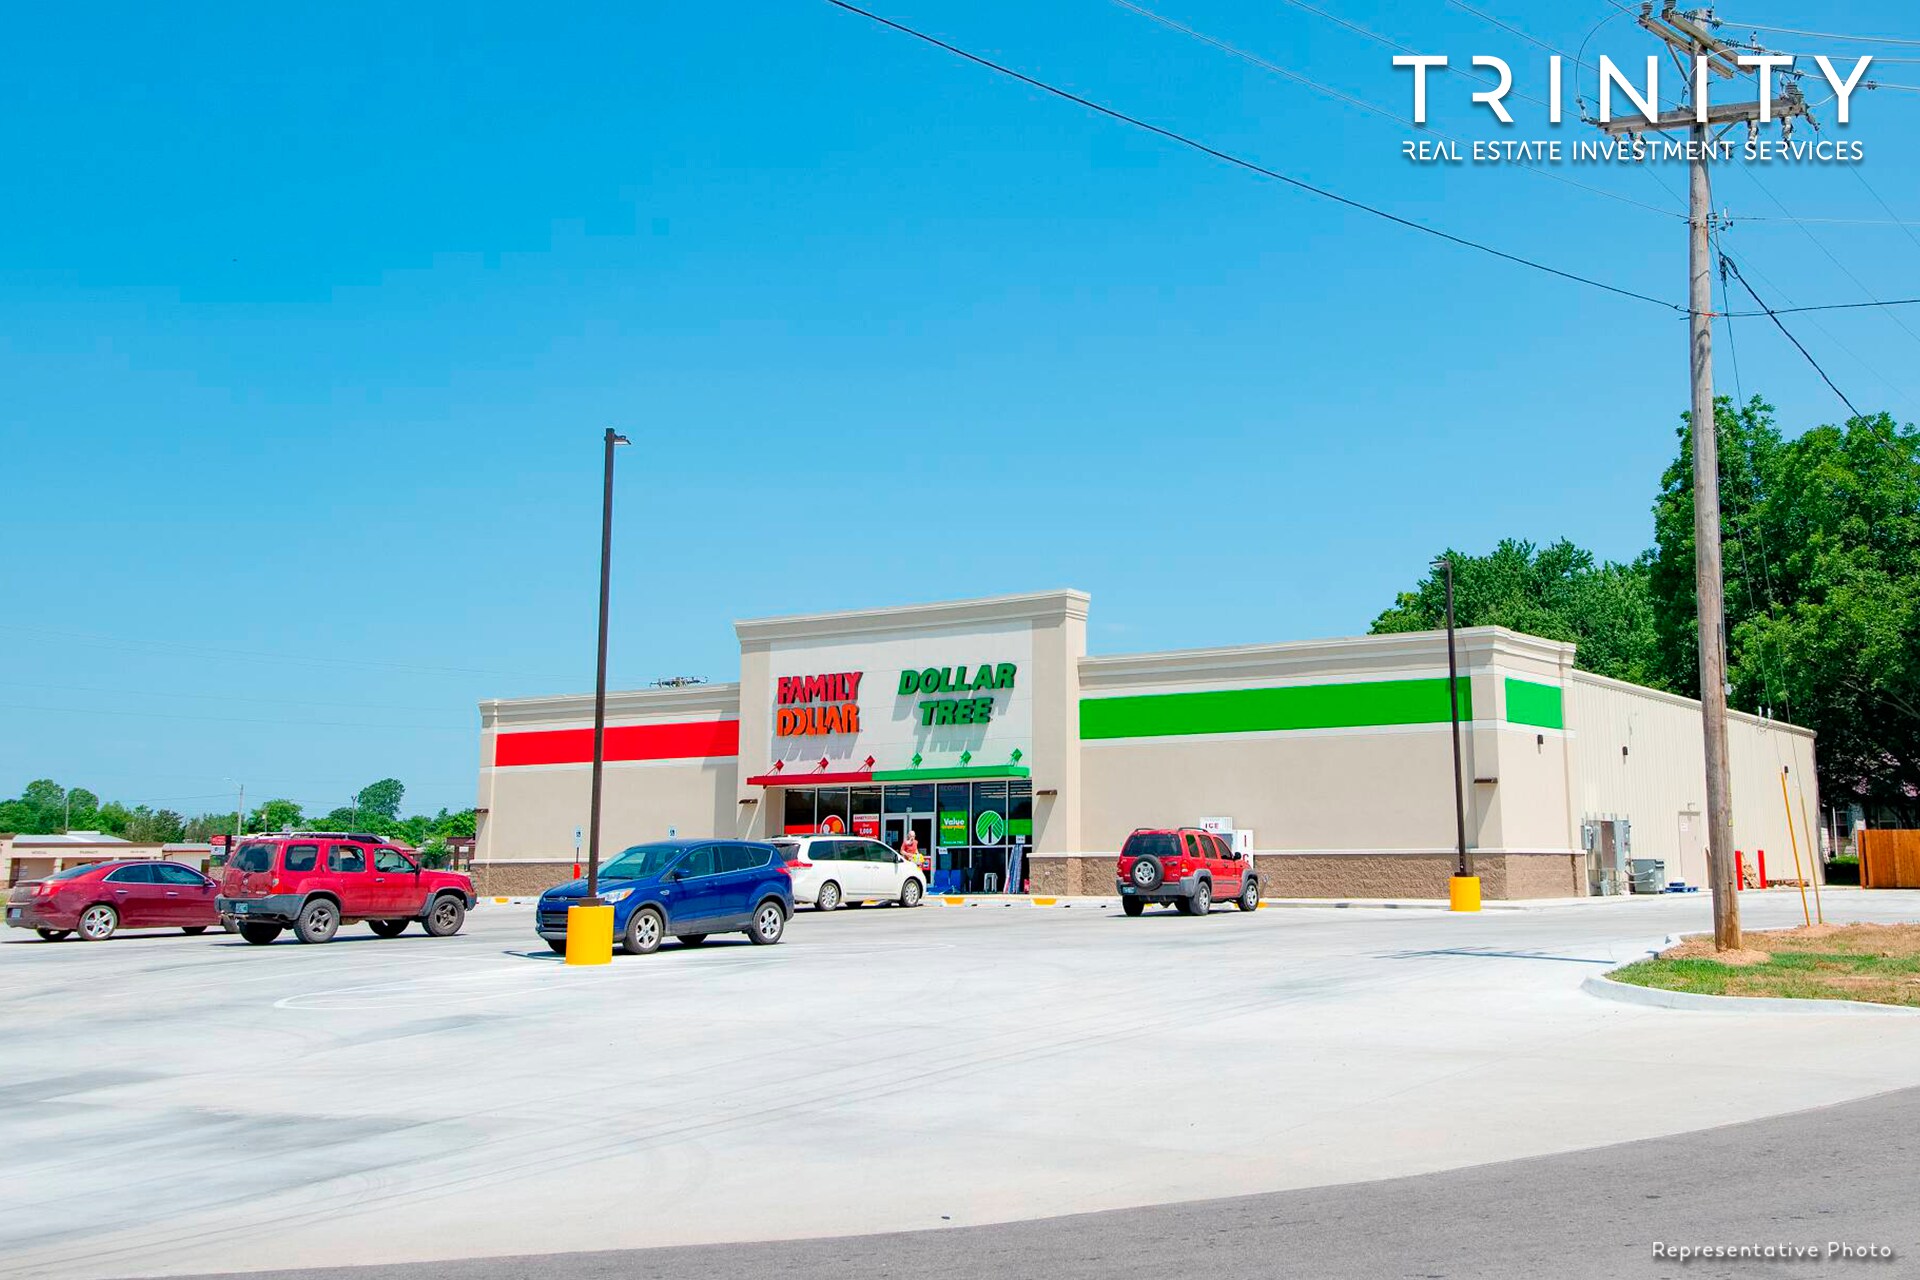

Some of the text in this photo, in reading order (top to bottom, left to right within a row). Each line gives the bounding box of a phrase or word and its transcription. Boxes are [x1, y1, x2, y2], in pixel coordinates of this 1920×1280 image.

[778, 672, 863, 704] FAMILY
[898, 663, 1017, 695] DOLLAR
[776, 703, 860, 736] DOLLAR
[919, 697, 993, 725] TREE
[943, 817, 965, 826] Value
